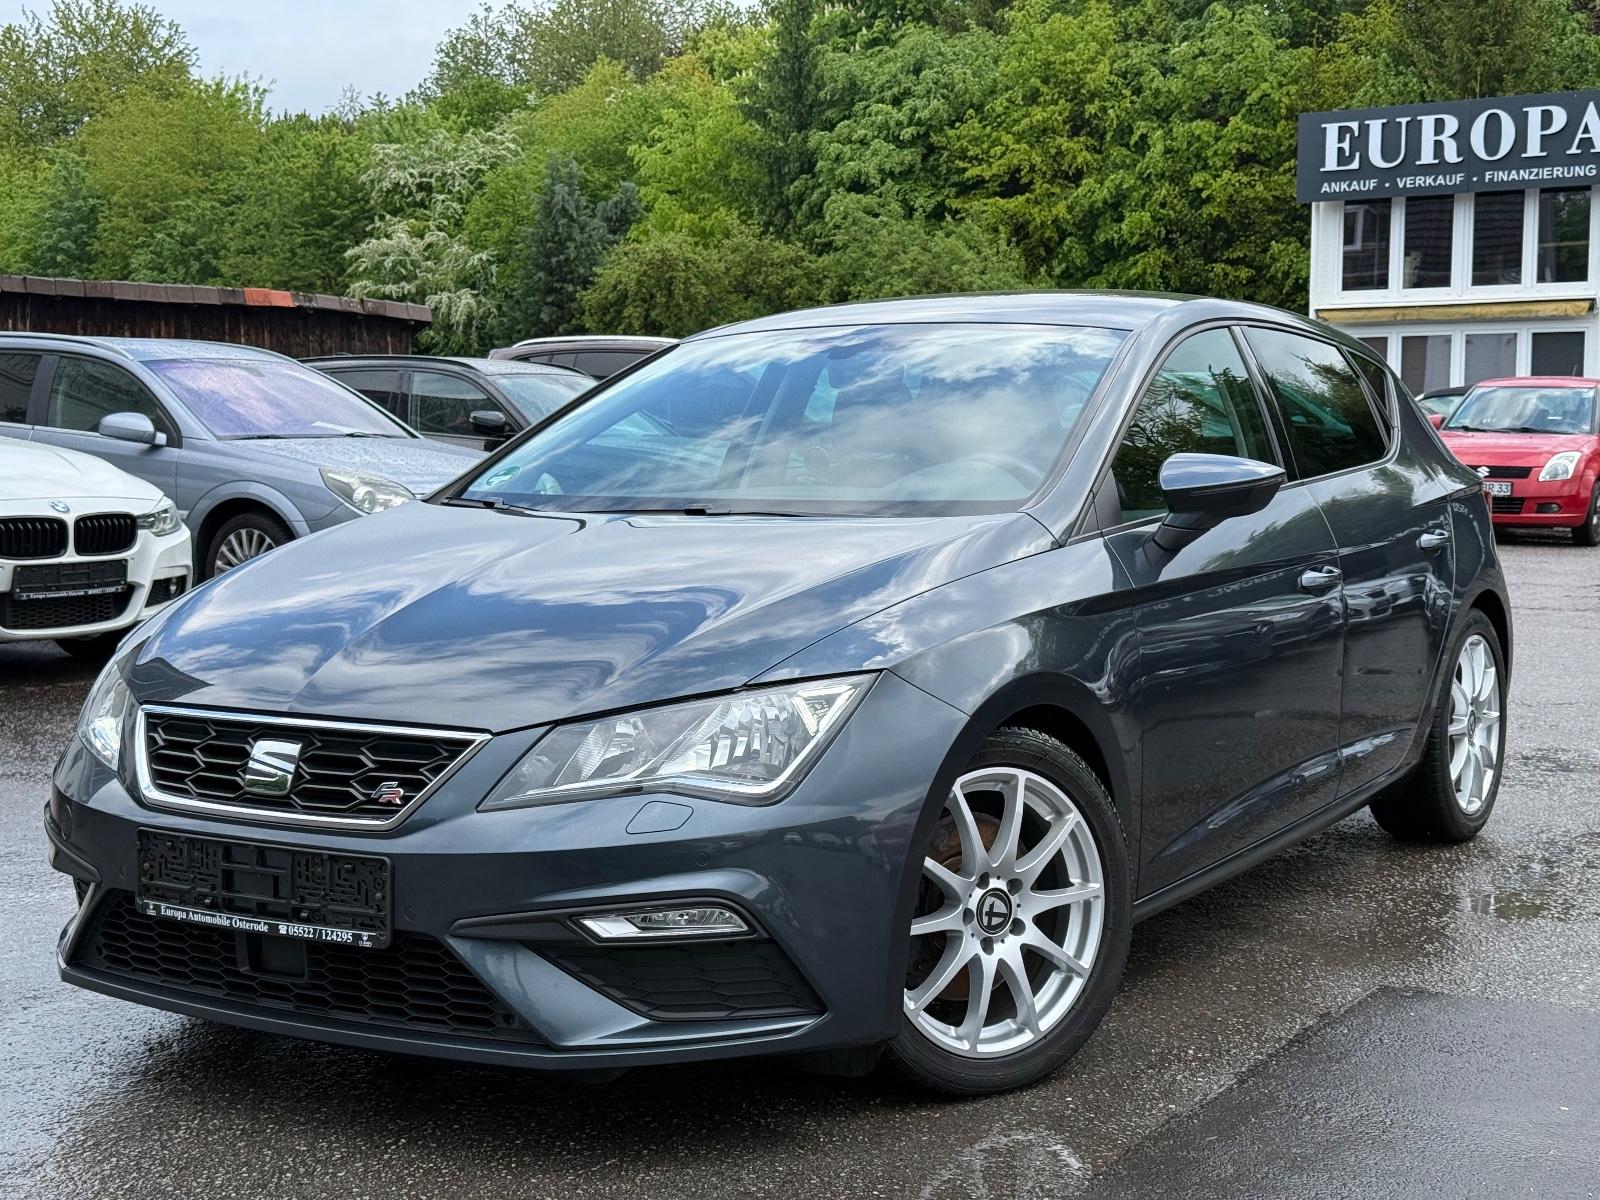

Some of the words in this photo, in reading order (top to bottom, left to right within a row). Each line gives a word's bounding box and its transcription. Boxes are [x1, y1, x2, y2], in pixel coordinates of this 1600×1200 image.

[1320, 101, 1600, 172] EUROPA
[1320, 178, 1378, 194] ANKAUF
[1397, 173, 1465, 189] VERKAUF
[1485, 164, 1597, 183] FINANZIERUNG
[1496, 484, 1510, 493] 33
[371, 781, 404, 804] FR
[160, 905, 187, 920] Europa
[188, 911, 230, 927] Automobile
[232, 917, 269, 932] Osterode
[288, 925, 314, 938] 05522
[322, 929, 353, 942] 124295
